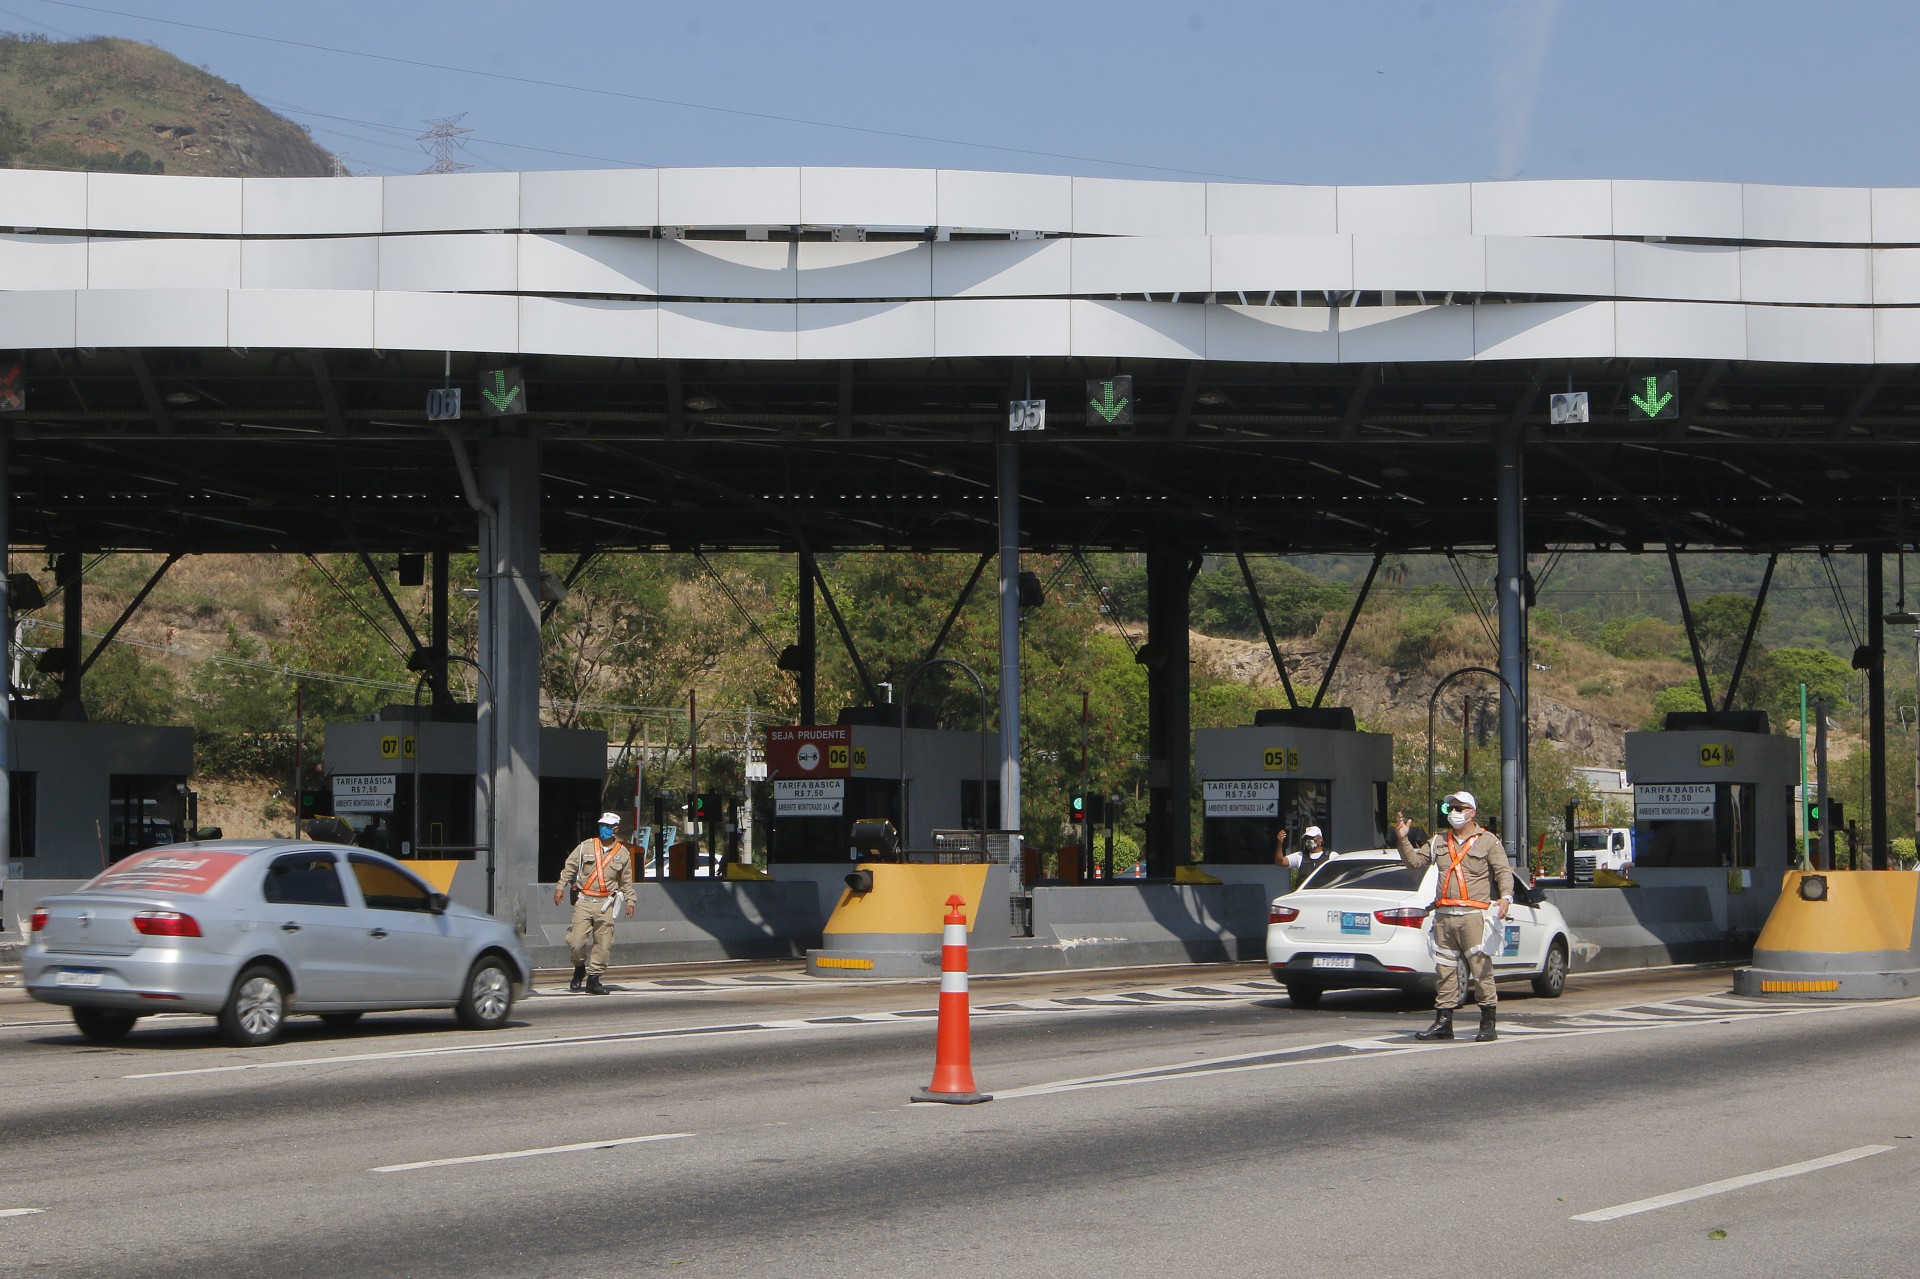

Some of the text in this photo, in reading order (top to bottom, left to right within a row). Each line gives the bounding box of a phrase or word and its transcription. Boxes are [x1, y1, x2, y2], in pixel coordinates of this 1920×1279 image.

[427, 390, 458, 417] 06
[1552, 394, 1585, 421] 04
[1010, 401, 1041, 428] 05
[772, 730, 846, 740] SEJA PRUDENTE
[382, 740, 397, 754] 07
[830, 750, 848, 764] 06
[854, 750, 866, 764] 06
[1265, 752, 1283, 766] 05
[1288, 753, 1298, 766] 05
[1702, 748, 1721, 762] 04
[364, 776, 392, 784] BÁSICA
[809, 780, 840, 788] BÁSICA
[1241, 781, 1274, 790] BÁSICA
[1675, 784, 1711, 793] BÁSICA
[1354, 916, 1369, 925] RIO
